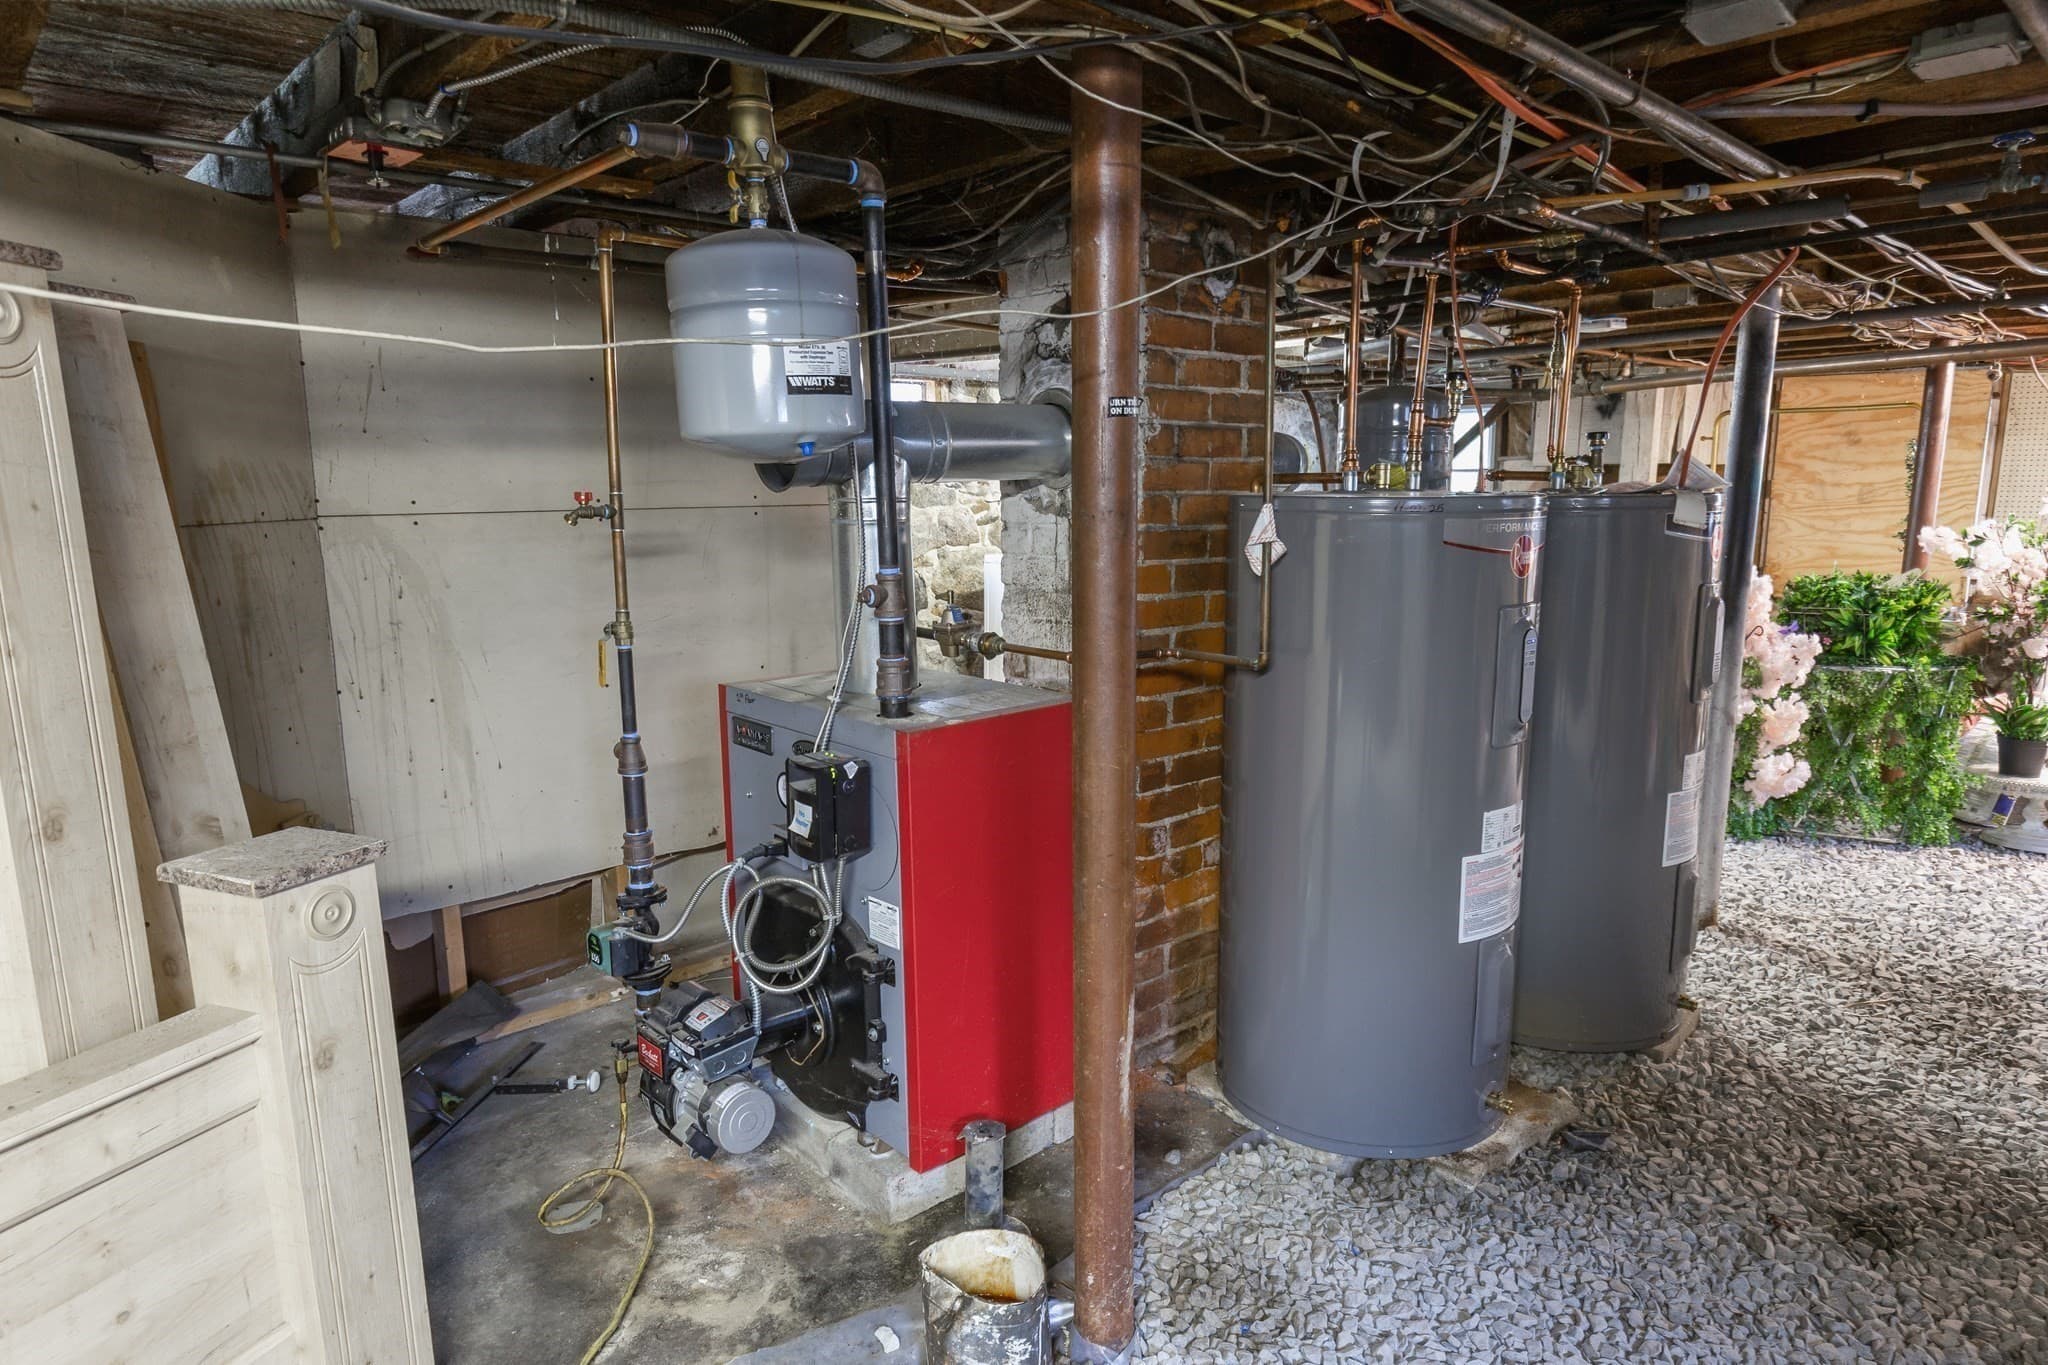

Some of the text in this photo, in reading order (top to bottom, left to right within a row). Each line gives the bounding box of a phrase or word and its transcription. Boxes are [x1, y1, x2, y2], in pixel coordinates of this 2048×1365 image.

[802, 376, 835, 386] WATTS
[1110, 407, 1122, 415] ON
[1480, 521, 1545, 533] ERFORMANCE
